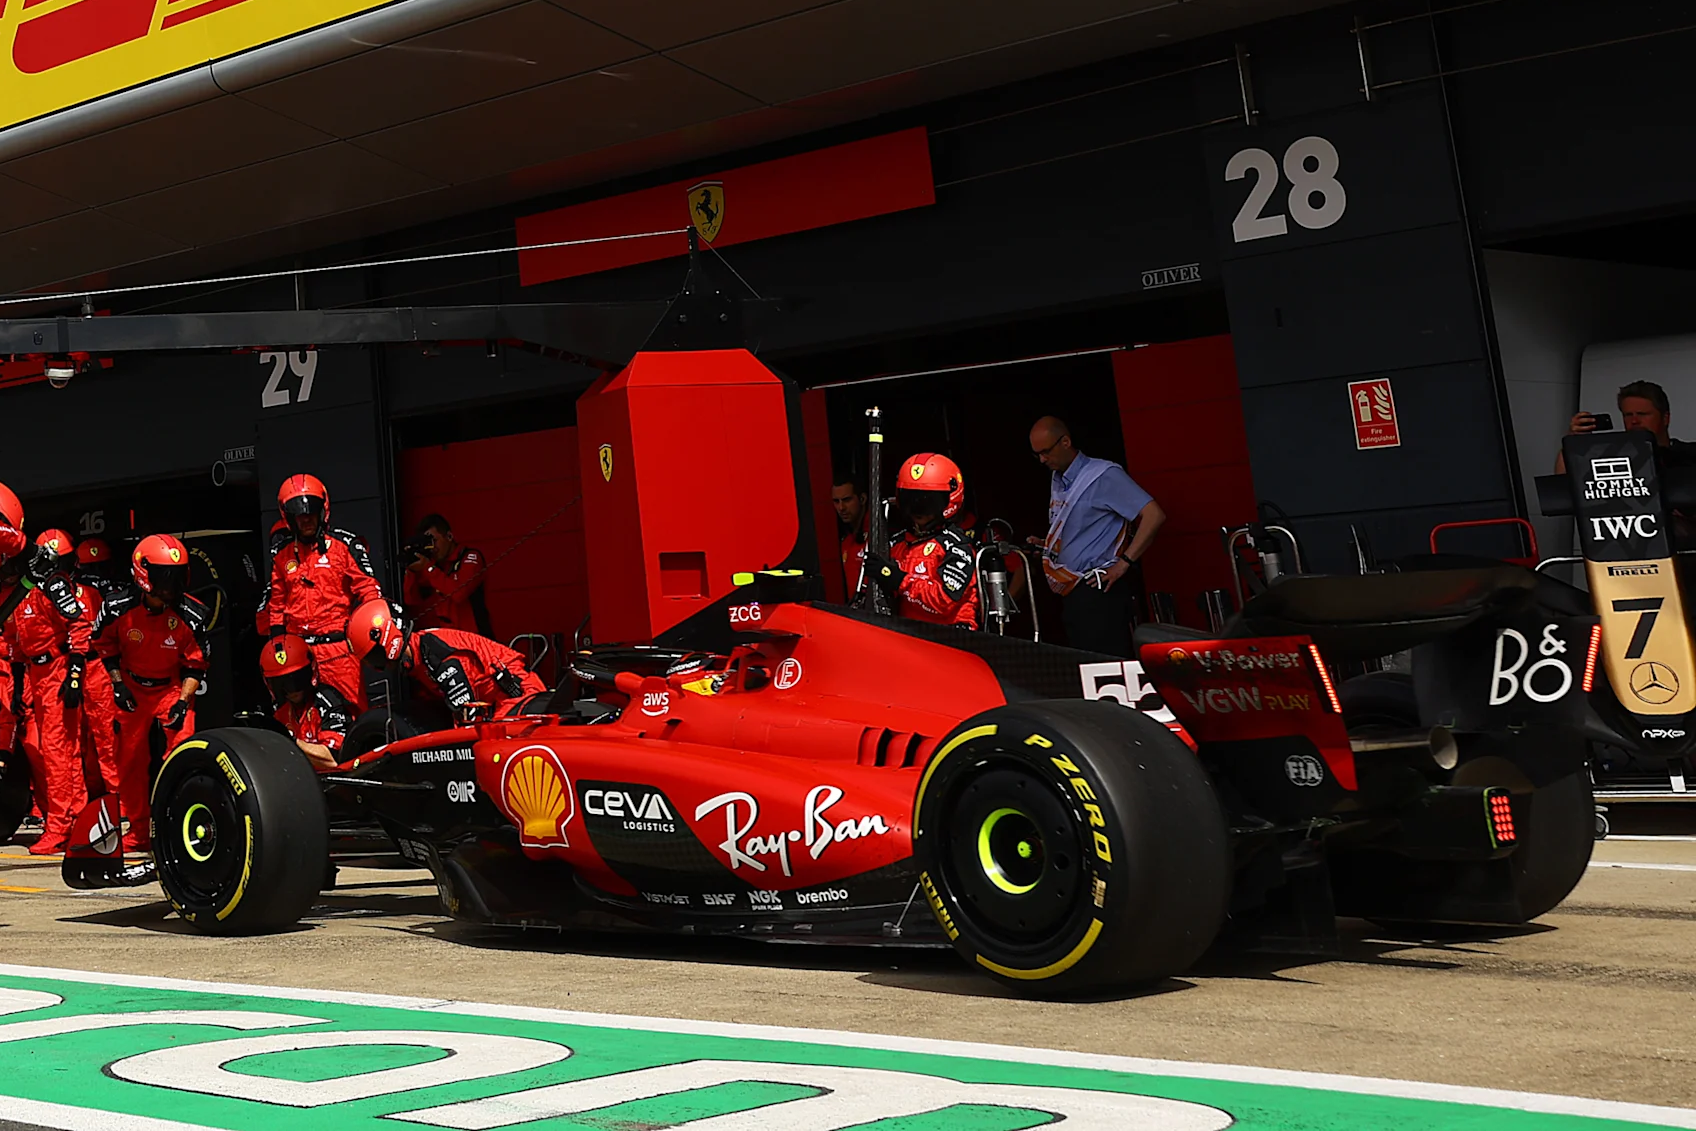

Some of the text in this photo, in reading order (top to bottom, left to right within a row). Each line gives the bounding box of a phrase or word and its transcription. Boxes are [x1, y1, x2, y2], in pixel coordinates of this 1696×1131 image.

[1225, 136, 1346, 242] 28
[1142, 265, 1200, 288] OLIVER
[260, 350, 318, 407] 29
[224, 447, 255, 461] OLIVER
[1585, 477, 1645, 490] TOMMY
[1585, 486, 1650, 500] HILFIGER
[1590, 514, 1658, 541] IWC
[1607, 564, 1659, 577] PIRELLI
[1611, 597, 1665, 659] 7
[1193, 648, 1300, 672] V-Power
[451, 692, 472, 707] VGW
[643, 692, 670, 707] aws
[1181, 686, 1263, 714] VGW
[412, 749, 454, 765] RICHARD
[215, 751, 247, 796] PIRELLI
[1023, 734, 1113, 863] P ZERO
[623, 821, 676, 833] LOGISTICS
[702, 893, 737, 906] SKF
[747, 889, 782, 904] NGK
[796, 887, 849, 905] brembo
[919, 871, 960, 941] PIRELLI
